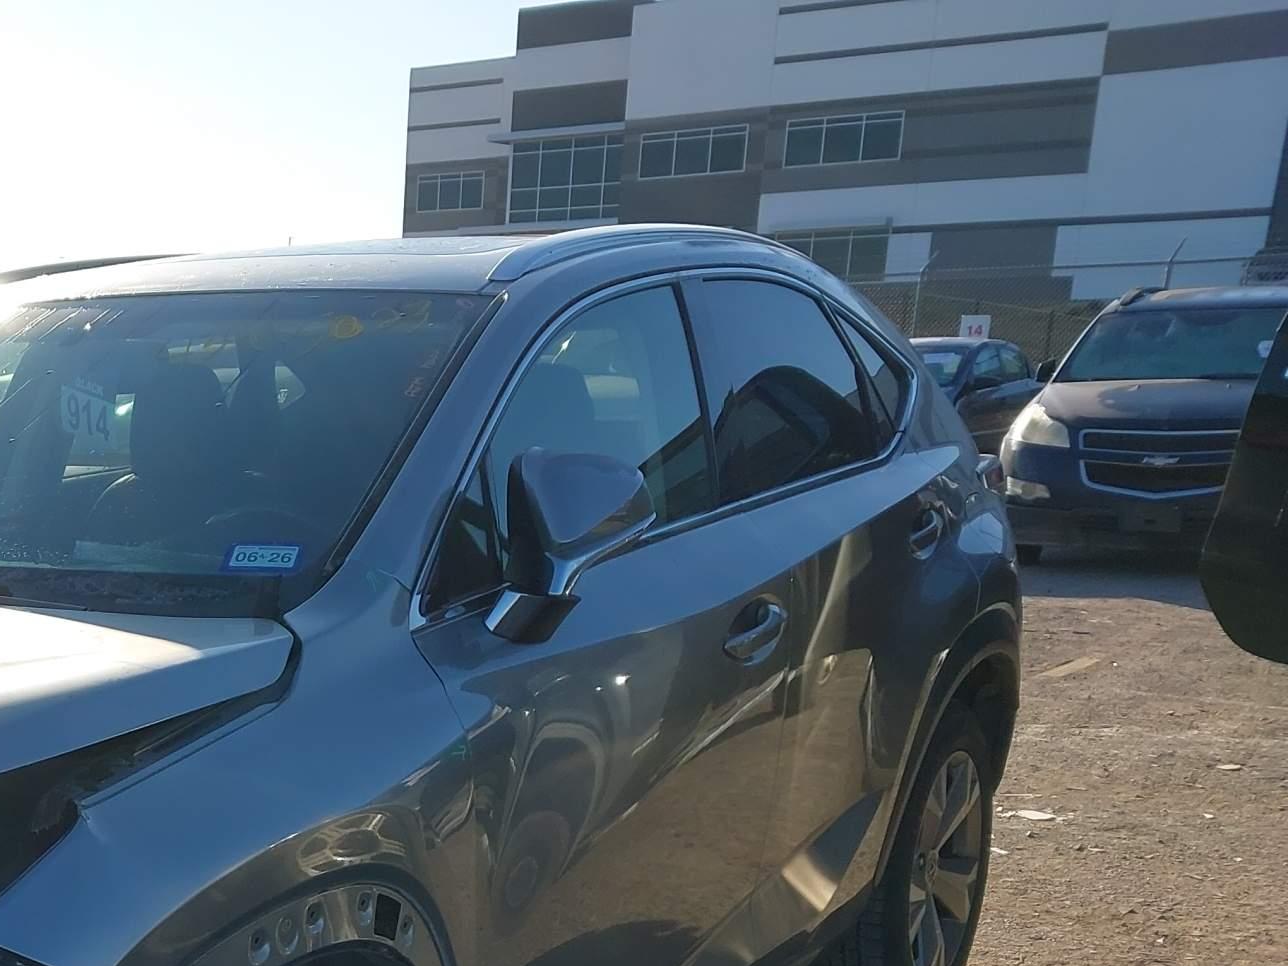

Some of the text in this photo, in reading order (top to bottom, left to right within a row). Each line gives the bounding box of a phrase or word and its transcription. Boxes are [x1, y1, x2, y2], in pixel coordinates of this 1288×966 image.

[967, 324, 984, 337] 14
[67, 392, 110, 441] 914
[235, 551, 293, 564] 06 26
